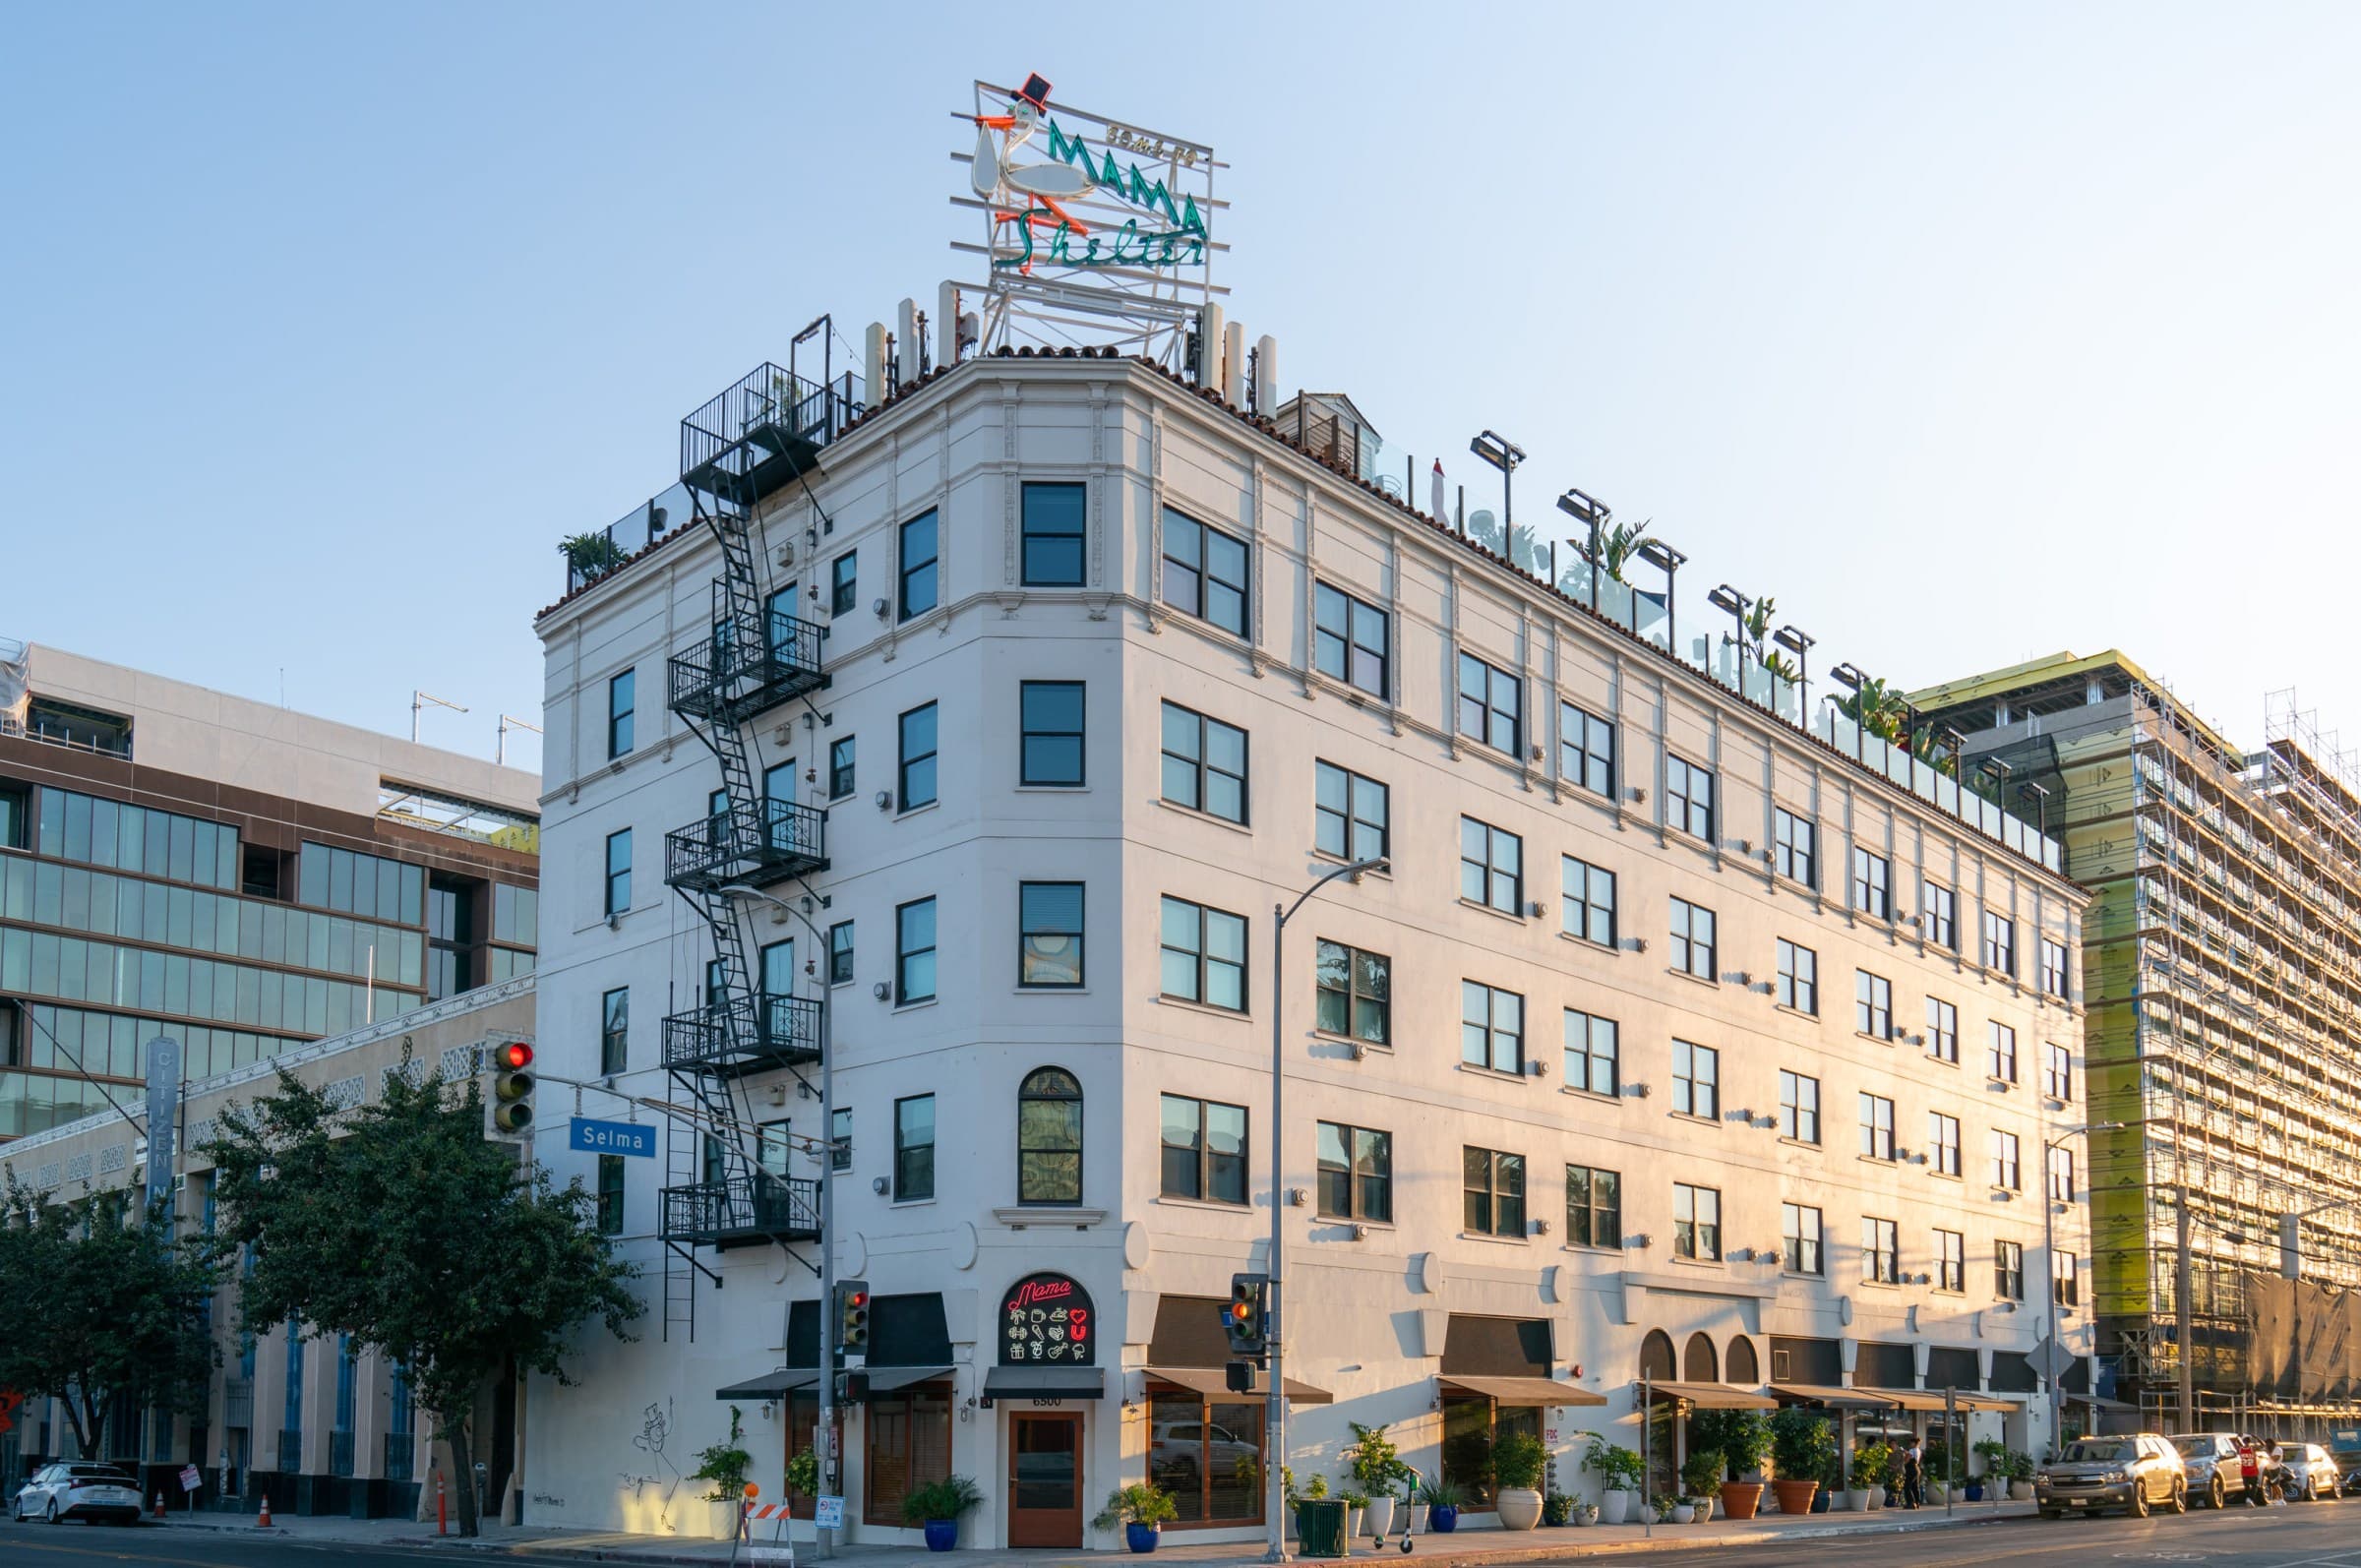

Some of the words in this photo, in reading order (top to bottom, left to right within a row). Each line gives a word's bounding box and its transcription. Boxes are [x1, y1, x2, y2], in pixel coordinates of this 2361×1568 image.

[1048, 117, 1208, 244] MAMA
[996, 208, 1204, 267] Shelter
[155, 1052, 172, 1168] CITIZEN
[583, 1126, 642, 1149] Selma
[1007, 1282, 1071, 1311] Mama
